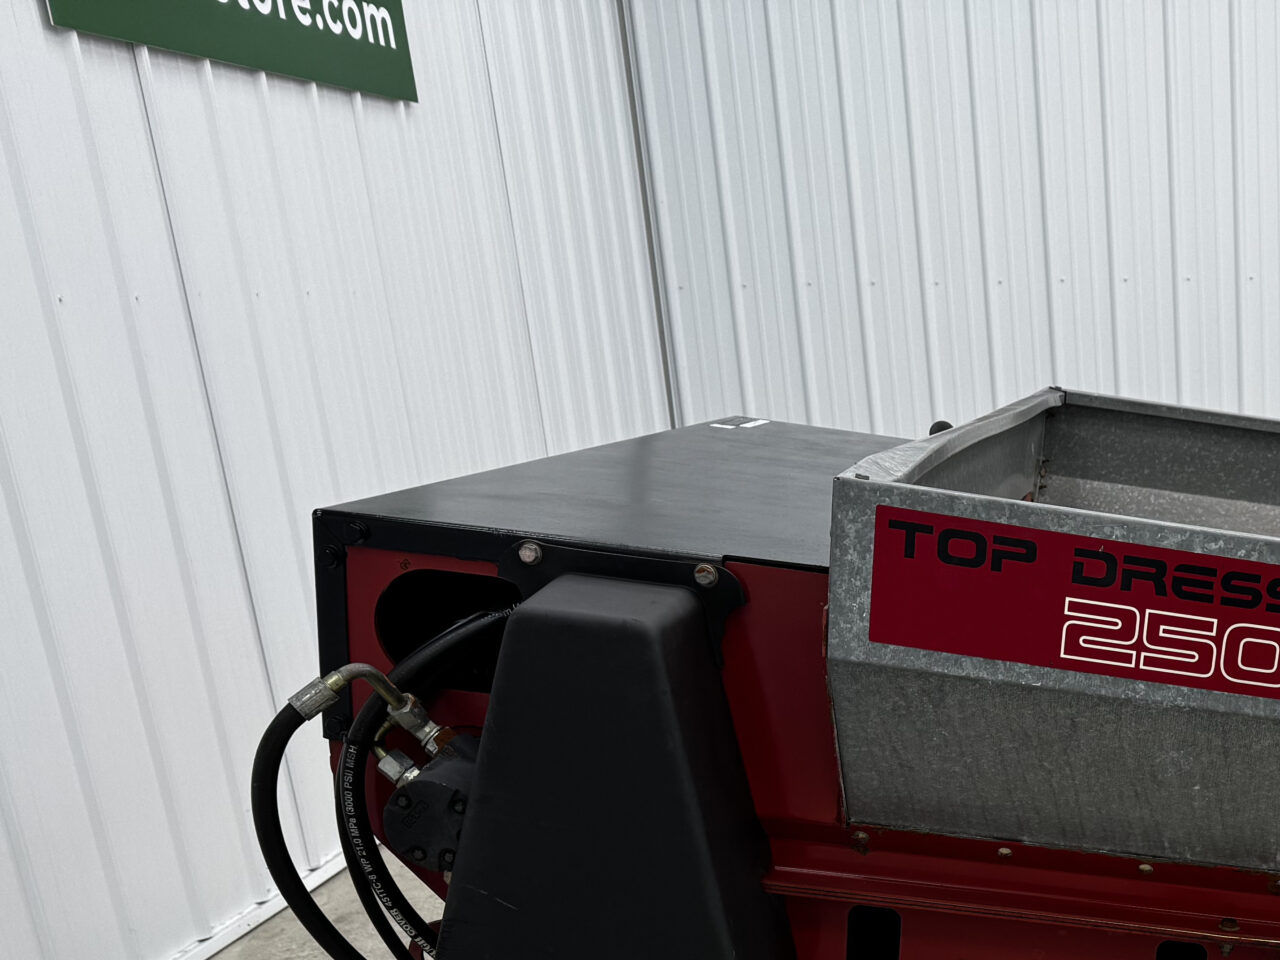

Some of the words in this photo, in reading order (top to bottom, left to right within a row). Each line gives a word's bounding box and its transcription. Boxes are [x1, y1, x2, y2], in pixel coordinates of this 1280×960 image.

[888, 519, 1038, 572] TOP
[343, 790, 356, 816] (3000
[360, 857, 373, 873] WP
[389, 907, 416, 937] COVER
